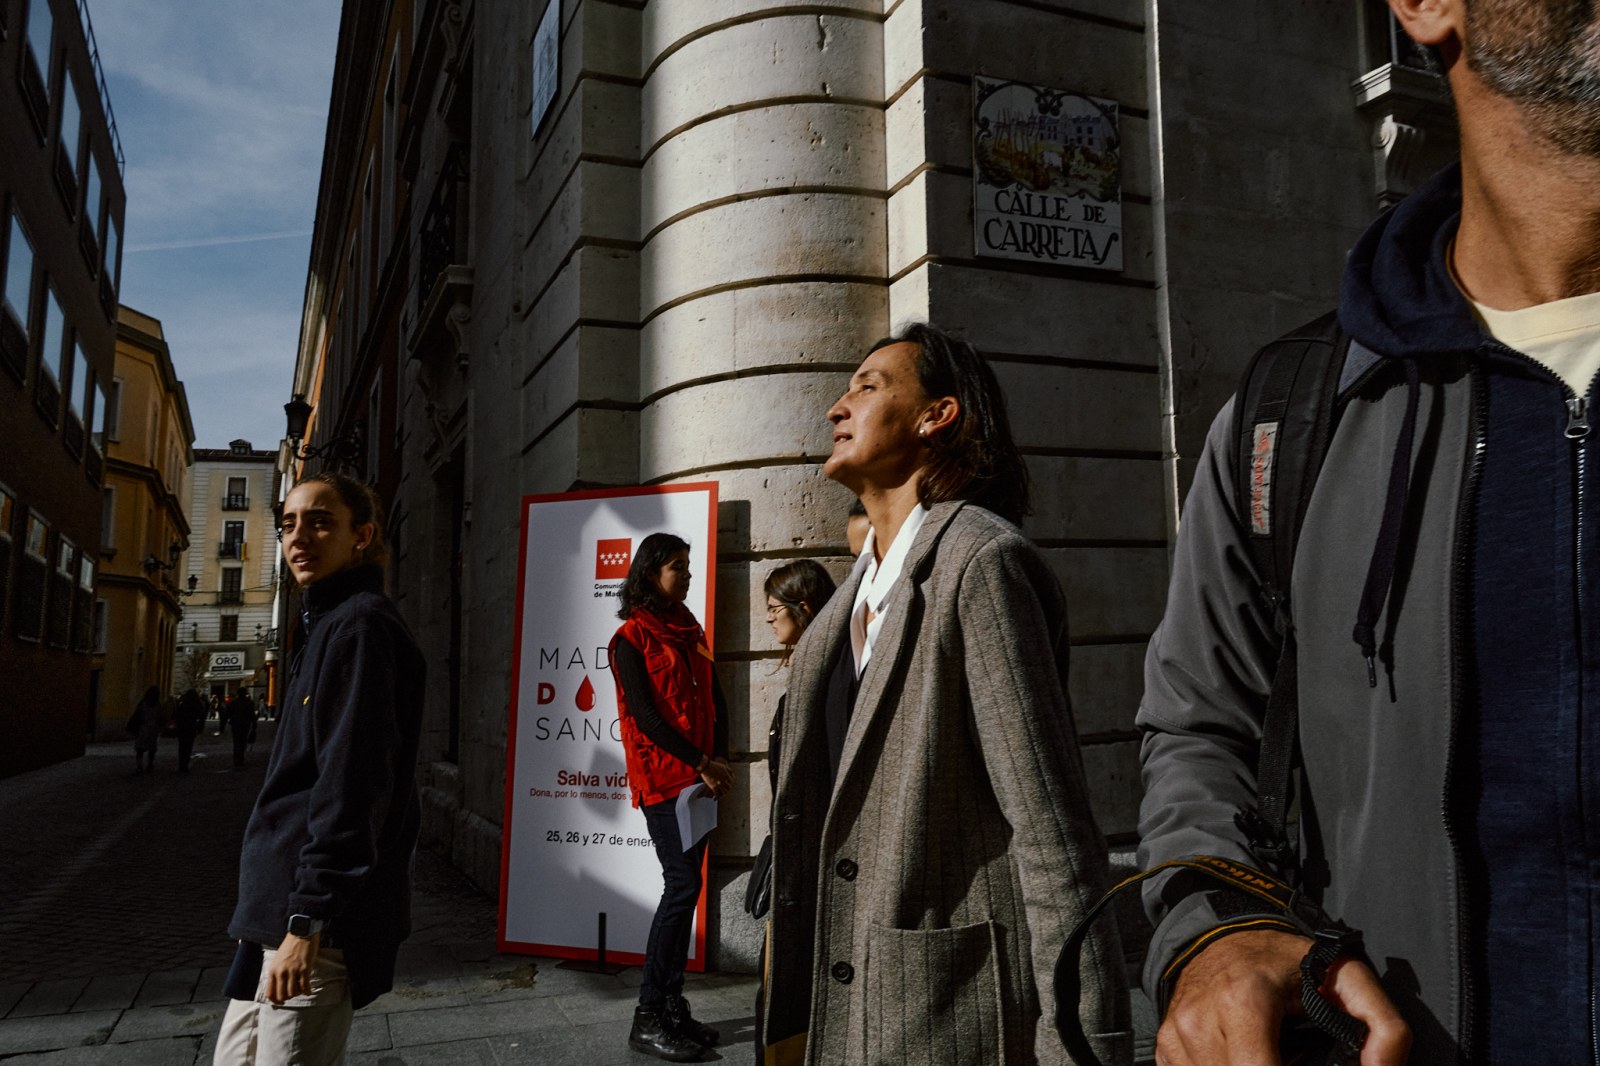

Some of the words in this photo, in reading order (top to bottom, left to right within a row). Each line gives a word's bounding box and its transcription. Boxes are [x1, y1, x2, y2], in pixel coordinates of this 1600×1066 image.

[994, 189, 1072, 221] CALLE
[1083, 204, 1107, 224] DE
[983, 217, 1119, 265] CARRETAS
[594, 582, 625, 590] Comunid
[605, 590, 621, 598] Mad
[215, 656, 239, 665] ORO
[539, 646, 611, 671] MAD
[557, 769, 600, 787] Salva
[605, 771, 629, 788] vid
[530, 787, 553, 798] Dona,
[554, 790, 570, 799] por
[570, 789, 578, 798] lo
[579, 791, 609, 801] menos,
[611, 791, 627, 800] dos
[546, 830, 563, 844] 25,
[565, 831, 580, 843] 26
[582, 834, 590, 846] y
[592, 833, 606, 844] 27
[609, 834, 623, 845] de
